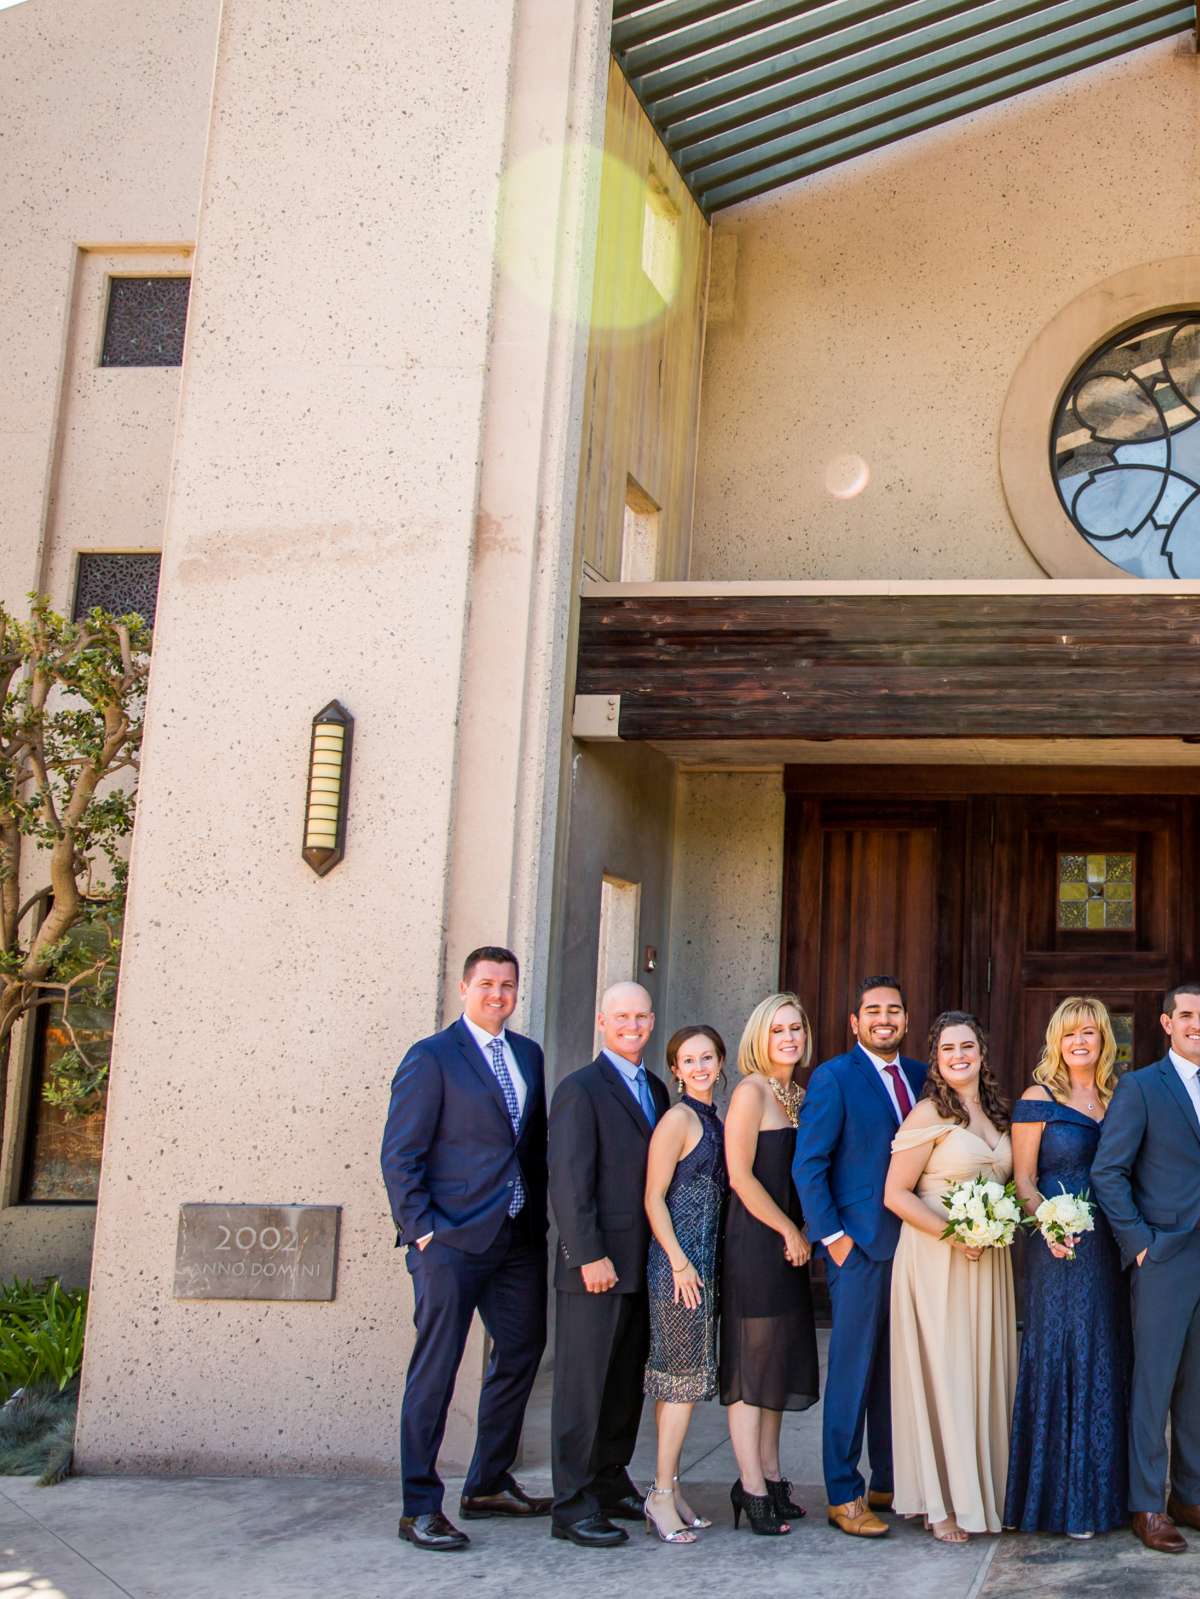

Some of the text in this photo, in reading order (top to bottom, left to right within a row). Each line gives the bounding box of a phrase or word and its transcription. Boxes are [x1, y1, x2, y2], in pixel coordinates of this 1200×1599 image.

[215, 1225, 299, 1251] 2002
[191, 1262, 321, 1278] ANNO DOMINI
